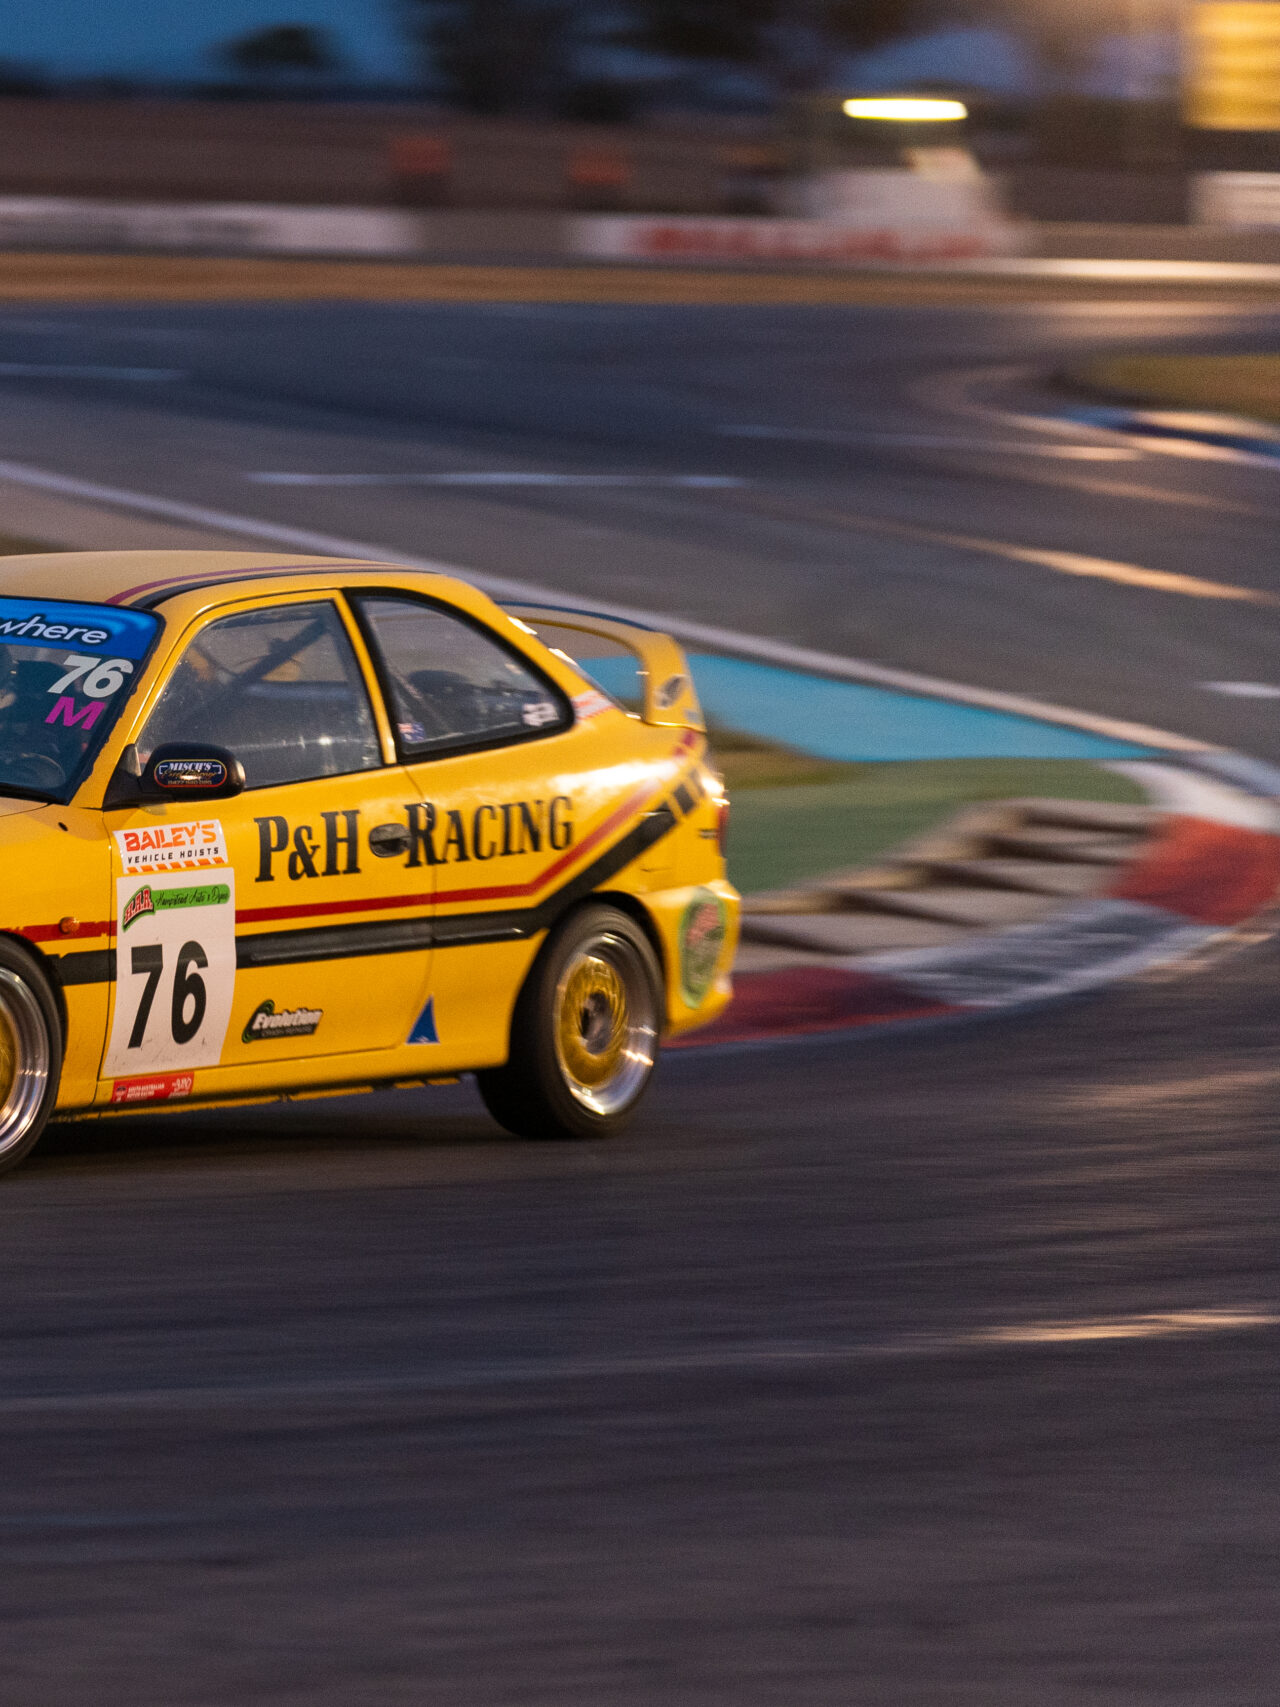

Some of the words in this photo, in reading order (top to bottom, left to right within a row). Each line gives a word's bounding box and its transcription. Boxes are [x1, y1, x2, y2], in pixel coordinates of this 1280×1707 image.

[46, 655, 134, 699] 76
[44, 696, 106, 731] M
[168, 762, 213, 771] MISCH'S
[123, 821, 218, 852] BAILEY'S
[253, 809, 362, 882] P&H
[403, 795, 575, 869] RACING
[127, 852, 174, 864] VEHICLE
[179, 846, 220, 859] HOISTS
[128, 940, 209, 1050] 76
